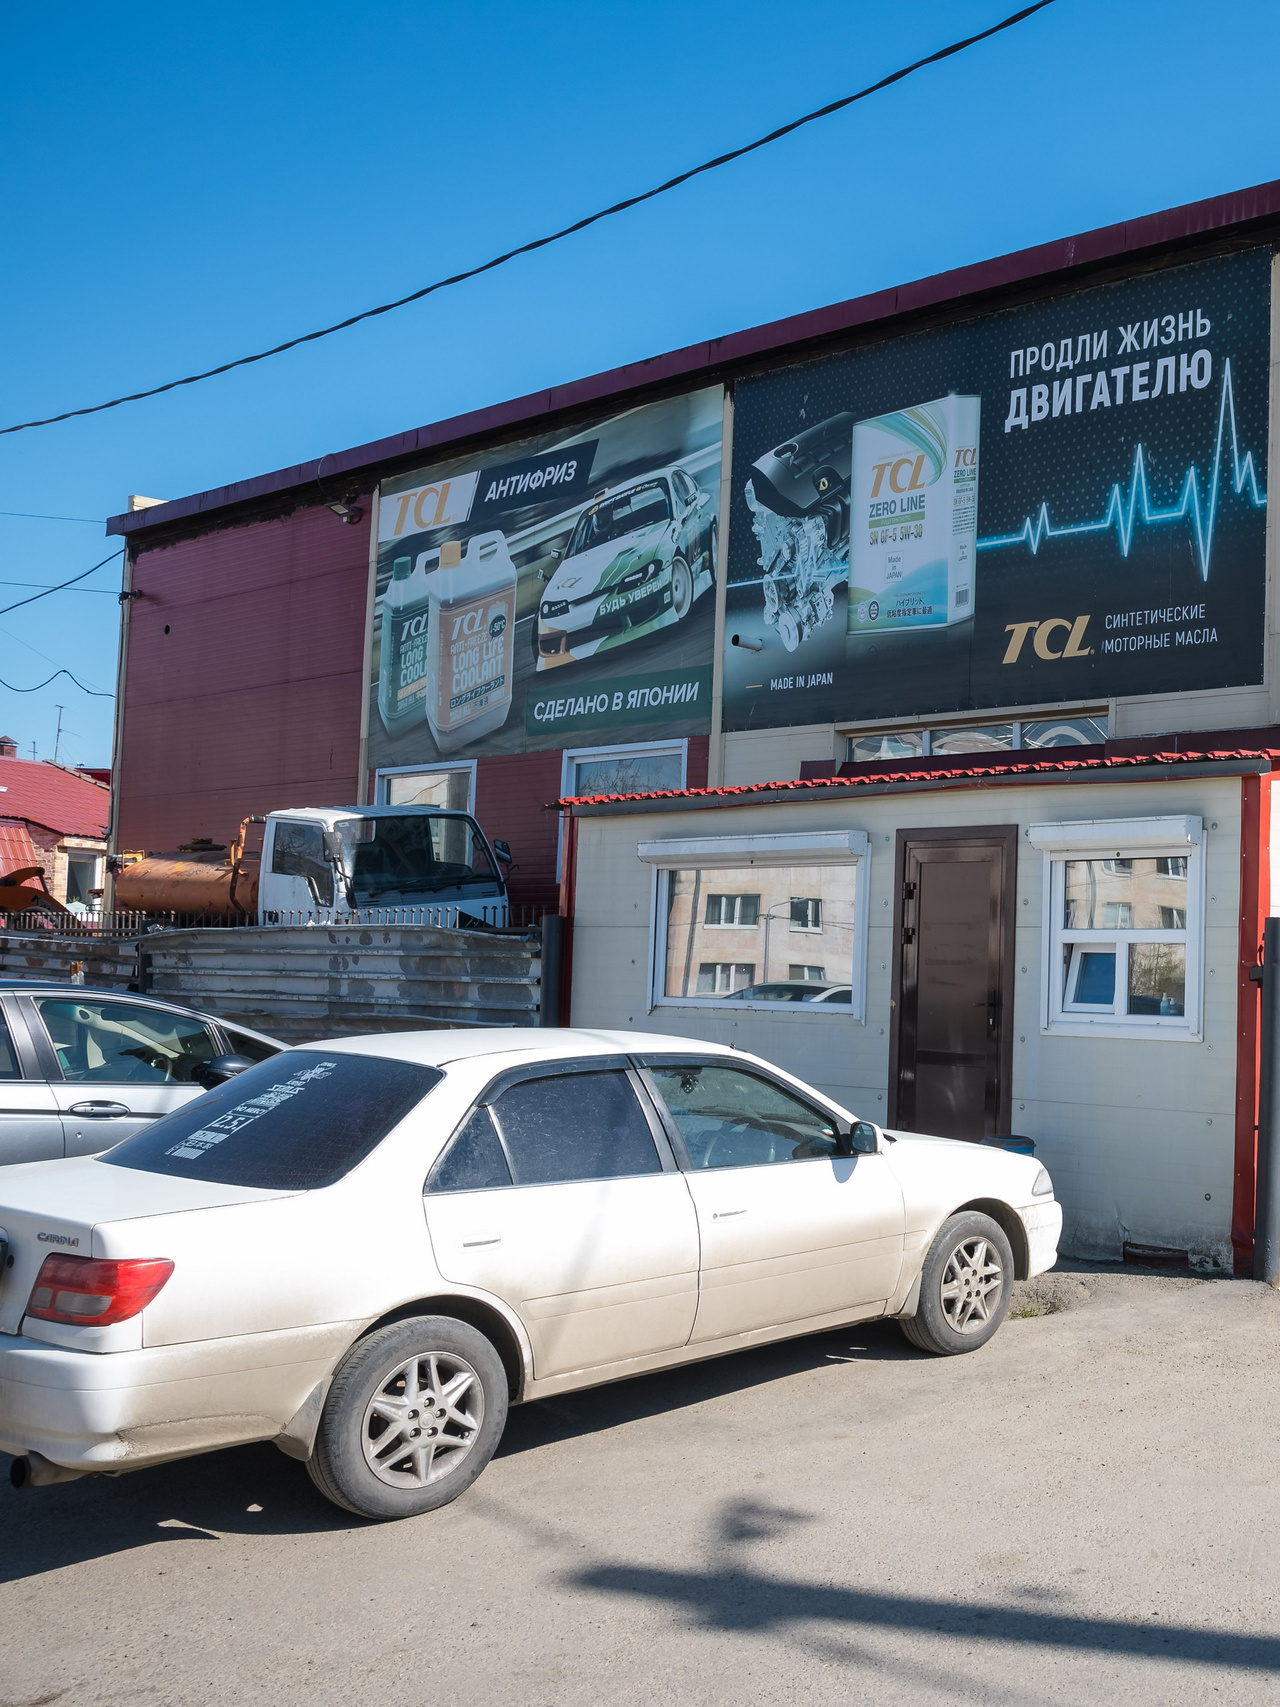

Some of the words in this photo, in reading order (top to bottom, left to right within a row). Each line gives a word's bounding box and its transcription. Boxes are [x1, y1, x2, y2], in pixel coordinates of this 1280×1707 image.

[1009, 329, 1108, 378] ПРОДЛИ
[1117, 308, 1212, 353] ЖИЗНЬ
[1004, 348, 1212, 433] ДВИГАТЕЛЮ
[954, 448, 976, 468] TCL
[484, 459, 578, 503] АНТИФРИЗ
[870, 453, 926, 498] TCL
[393, 482, 452, 536] TCL
[869, 500, 897, 518] ZERO
[900, 494, 926, 513] LINE
[869, 530, 878, 546] SN
[880, 528, 897, 545] GF-5
[899, 523, 923, 541] 5W-30
[887, 555, 902, 563] Made
[886, 571, 902, 580] JAPAN
[599, 596, 626, 615] БУДЬ
[628, 579, 664, 602] УВЕРЕН
[451, 608, 483, 640] TCL
[1104, 603, 1206, 630] СИНТЕТИЧЕСКИЕ
[1002, 615, 1092, 665] TCL
[1103, 631, 1171, 654] МОТОРНЫЕ
[1175, 626, 1218, 648] МАСЛА
[401, 645, 424, 669] LONG
[452, 646, 480, 673] LONG
[452, 654, 505, 694] COOLANT
[769, 675, 794, 691] MADE
[796, 674, 806, 689] IN
[806, 671, 834, 688] JAPAN
[533, 692, 610, 722] СДЕЛАНО
[611, 692, 623, 711] В
[626, 681, 700, 708] ЯПОНИИ
